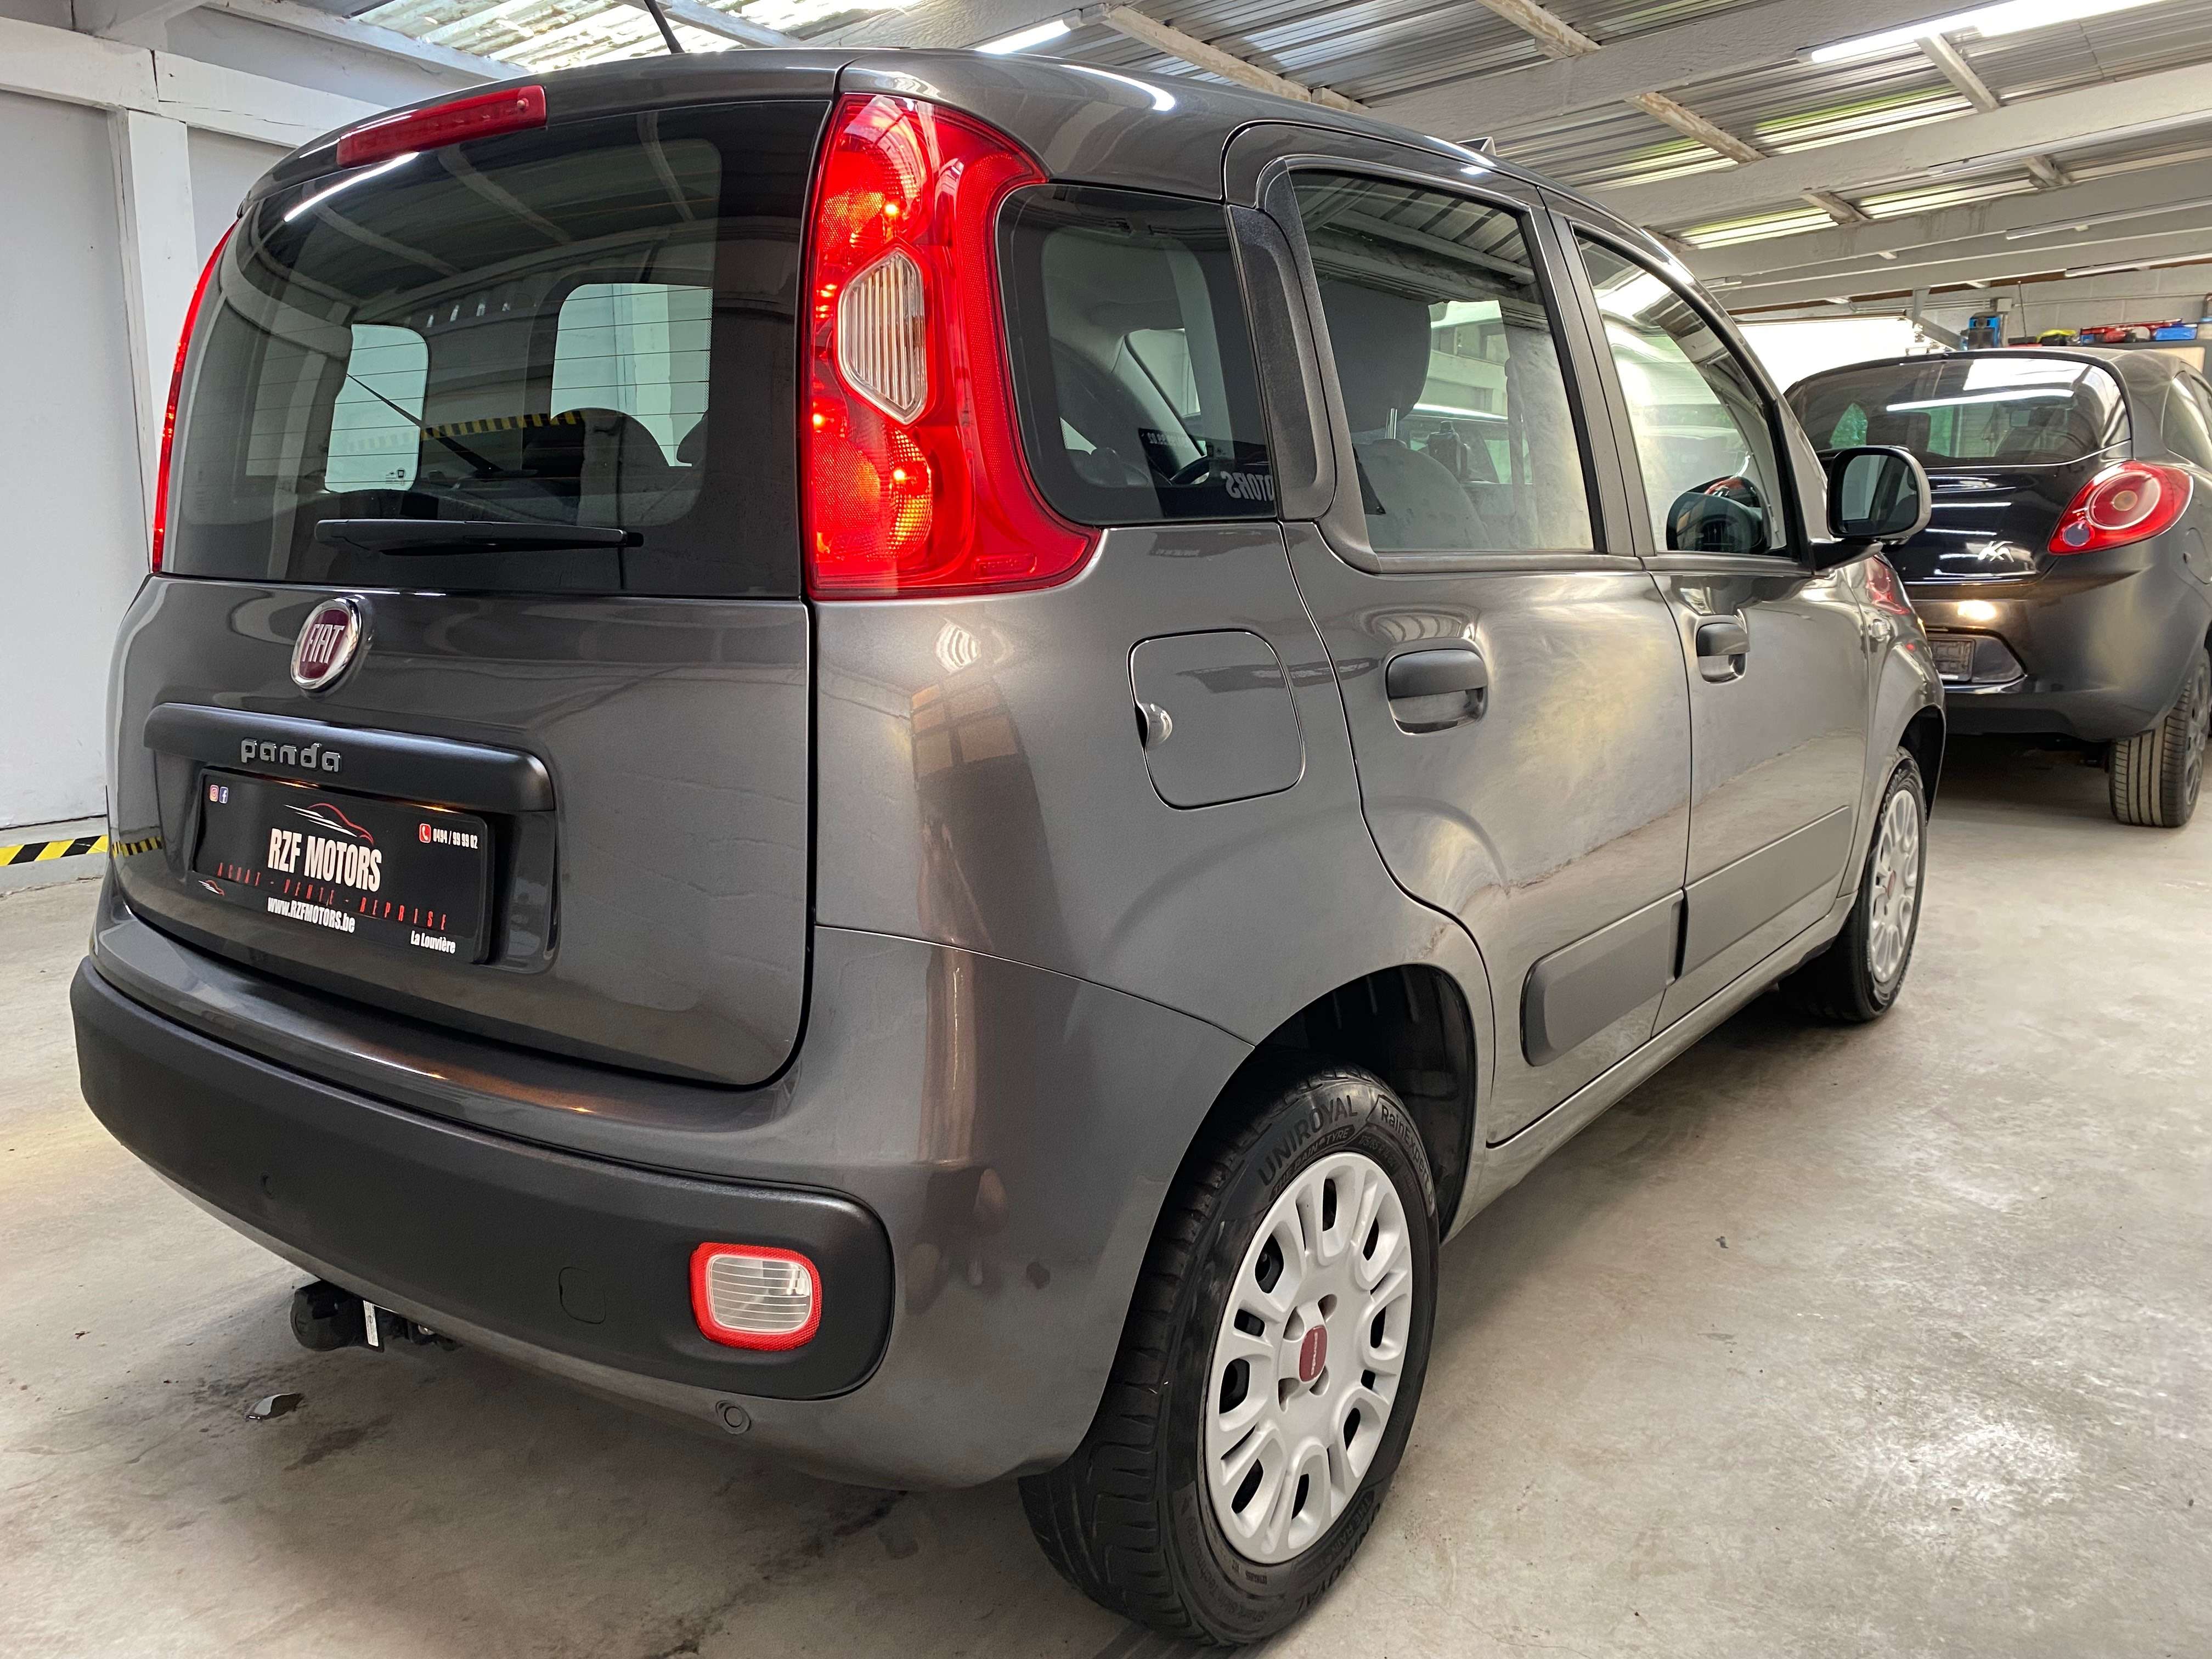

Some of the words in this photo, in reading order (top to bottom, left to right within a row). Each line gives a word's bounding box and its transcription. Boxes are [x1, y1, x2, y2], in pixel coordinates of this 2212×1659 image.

[302, 623, 346, 664] FIAT
[241, 738, 341, 772] panda
[433, 828, 448, 844] 0494
[453, 832, 461, 845] 99
[461, 833, 470, 848] 99
[470, 834, 478, 849] 02
[268, 828, 302, 873] RZF
[304, 835, 382, 892] MOTORS
[359, 897, 447, 930] REPRISE
[410, 930, 420, 946] La
[420, 932, 456, 954] Louvière
[1256, 1095, 1358, 1186] UNIROYAL
[1326, 1128, 1349, 1145] TYRE
